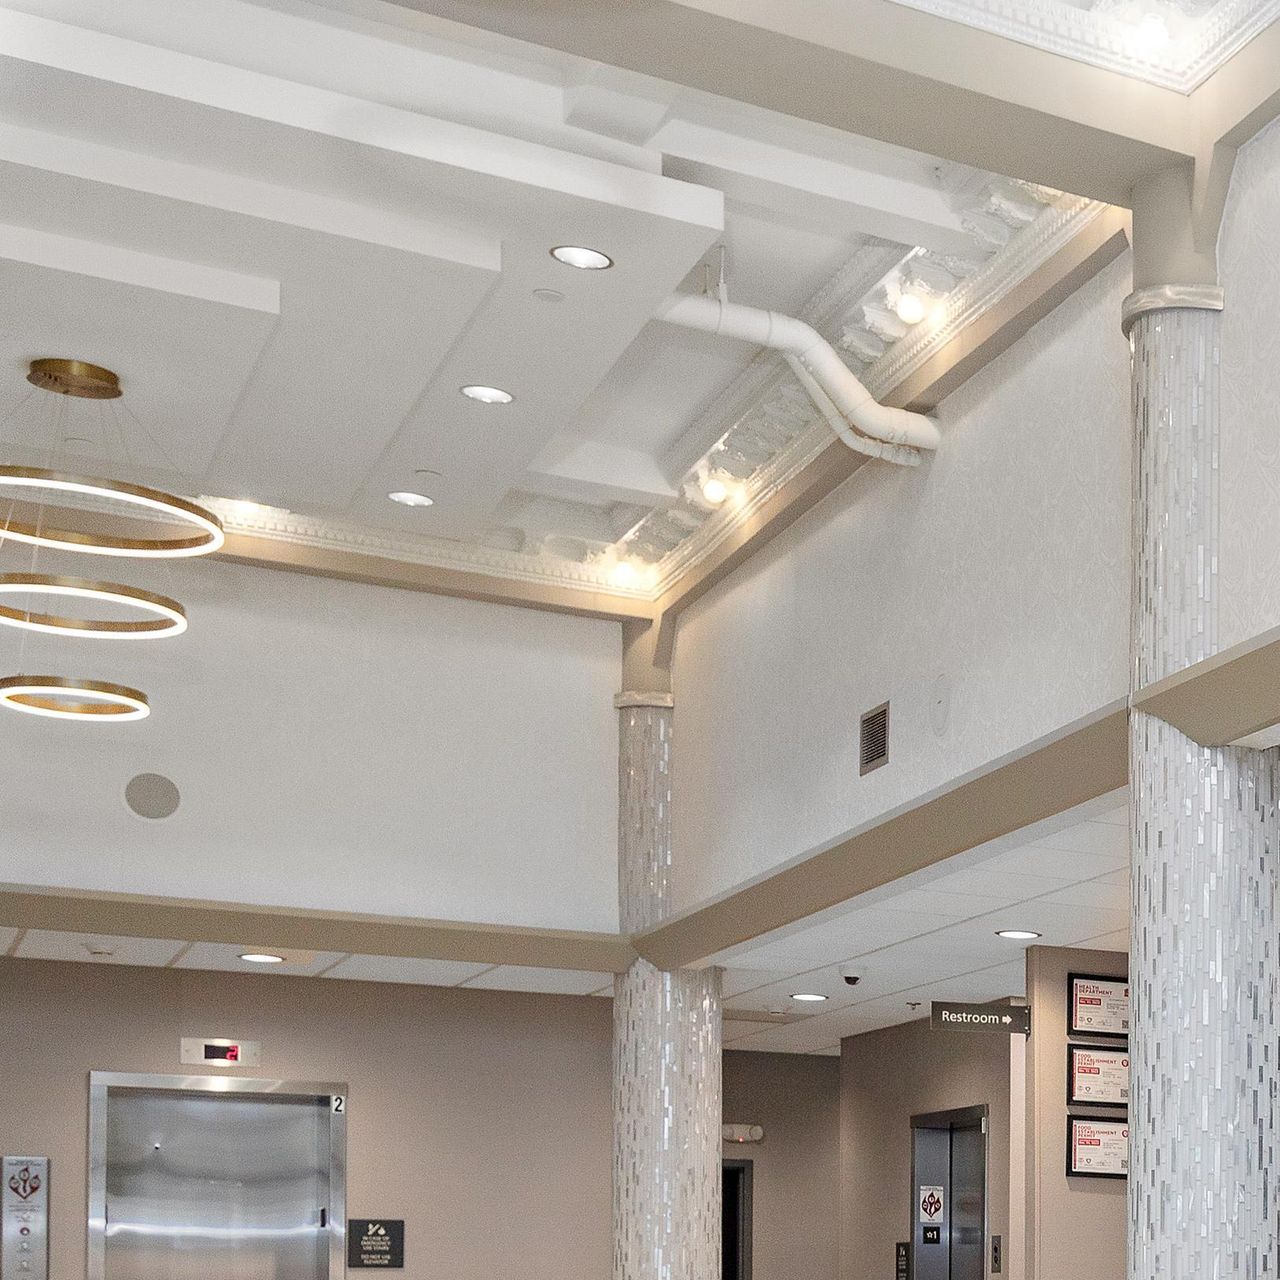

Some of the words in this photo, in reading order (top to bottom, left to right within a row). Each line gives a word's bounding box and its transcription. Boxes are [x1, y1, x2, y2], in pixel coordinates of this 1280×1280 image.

[941, 1010, 999, 1024] Restroom
[225, 1045, 239, 1061] 2
[334, 1096, 343, 1112] 2
